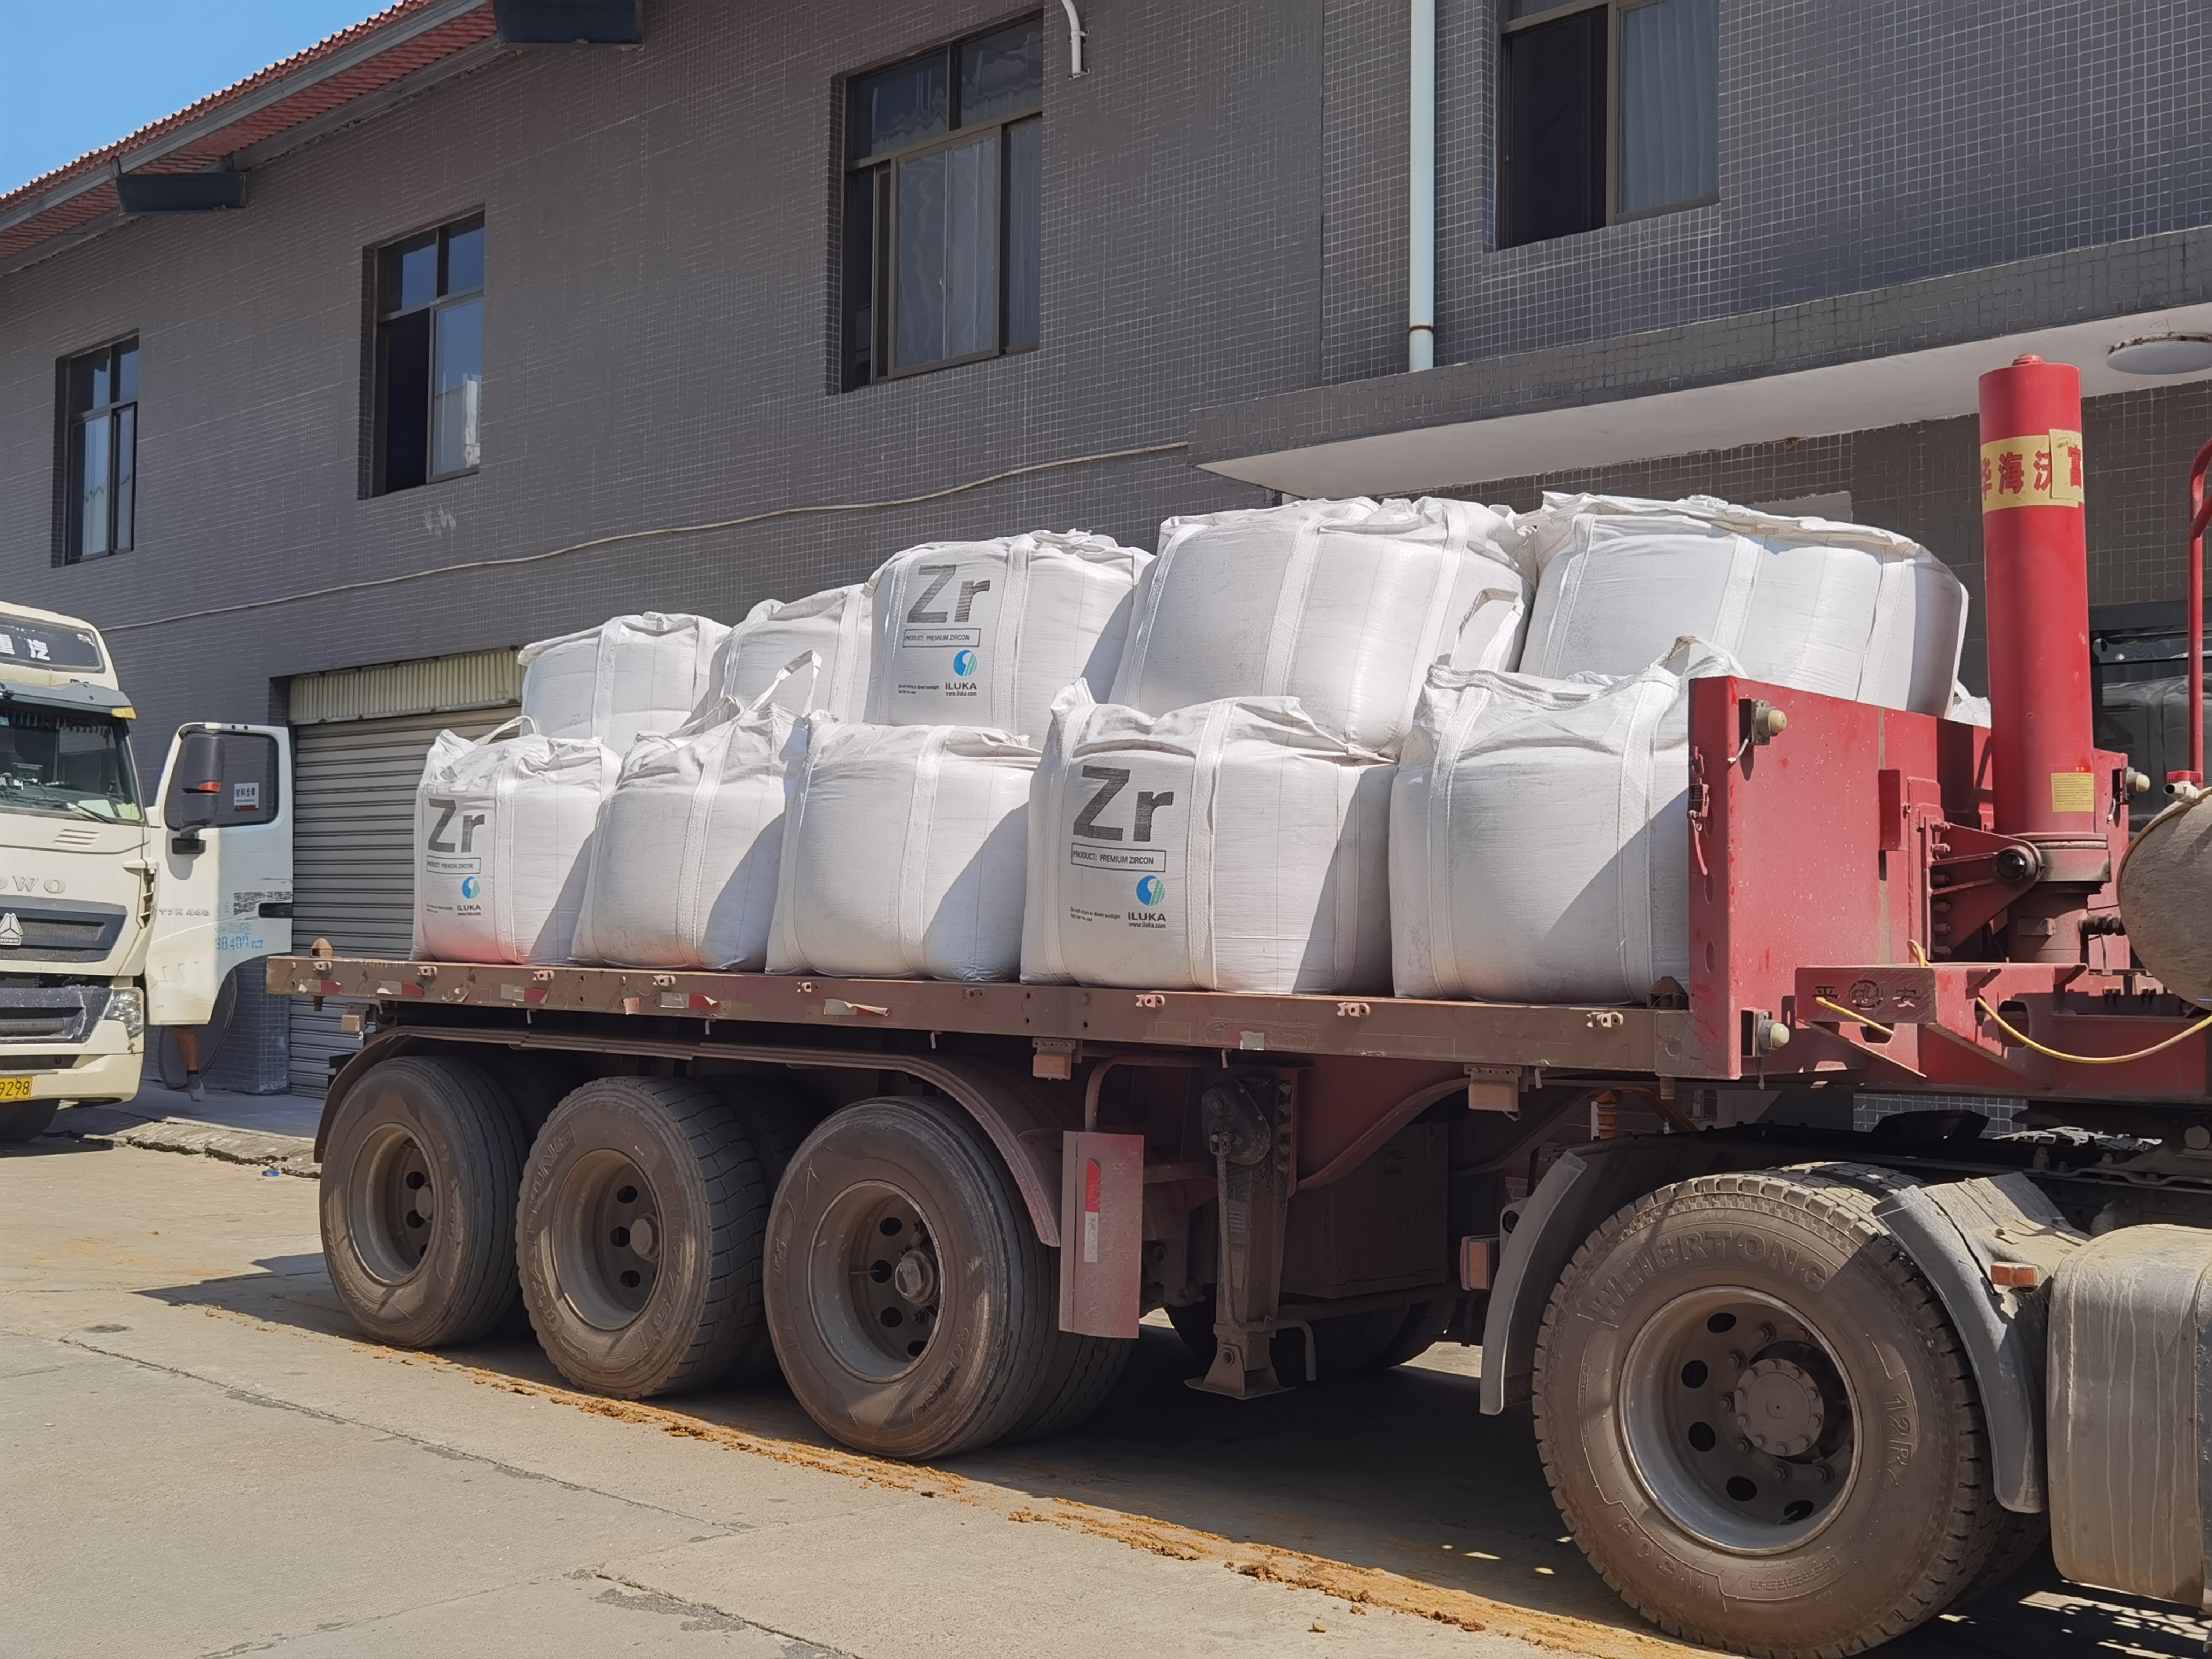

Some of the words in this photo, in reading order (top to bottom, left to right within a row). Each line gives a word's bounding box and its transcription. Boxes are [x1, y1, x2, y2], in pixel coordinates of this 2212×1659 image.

[906, 564, 991, 623] Zr
[428, 798, 485, 853] Zr
[1073, 765, 1174, 842] Zr
[1073, 850, 1097, 861] PRODUCT:
[1100, 854, 1128, 864] PREMIUM
[1129, 856, 1154, 864] ZIRCON
[1128, 912, 1166, 921] ILUKA
[1588, 1229, 1829, 1319] WEIERTONG
